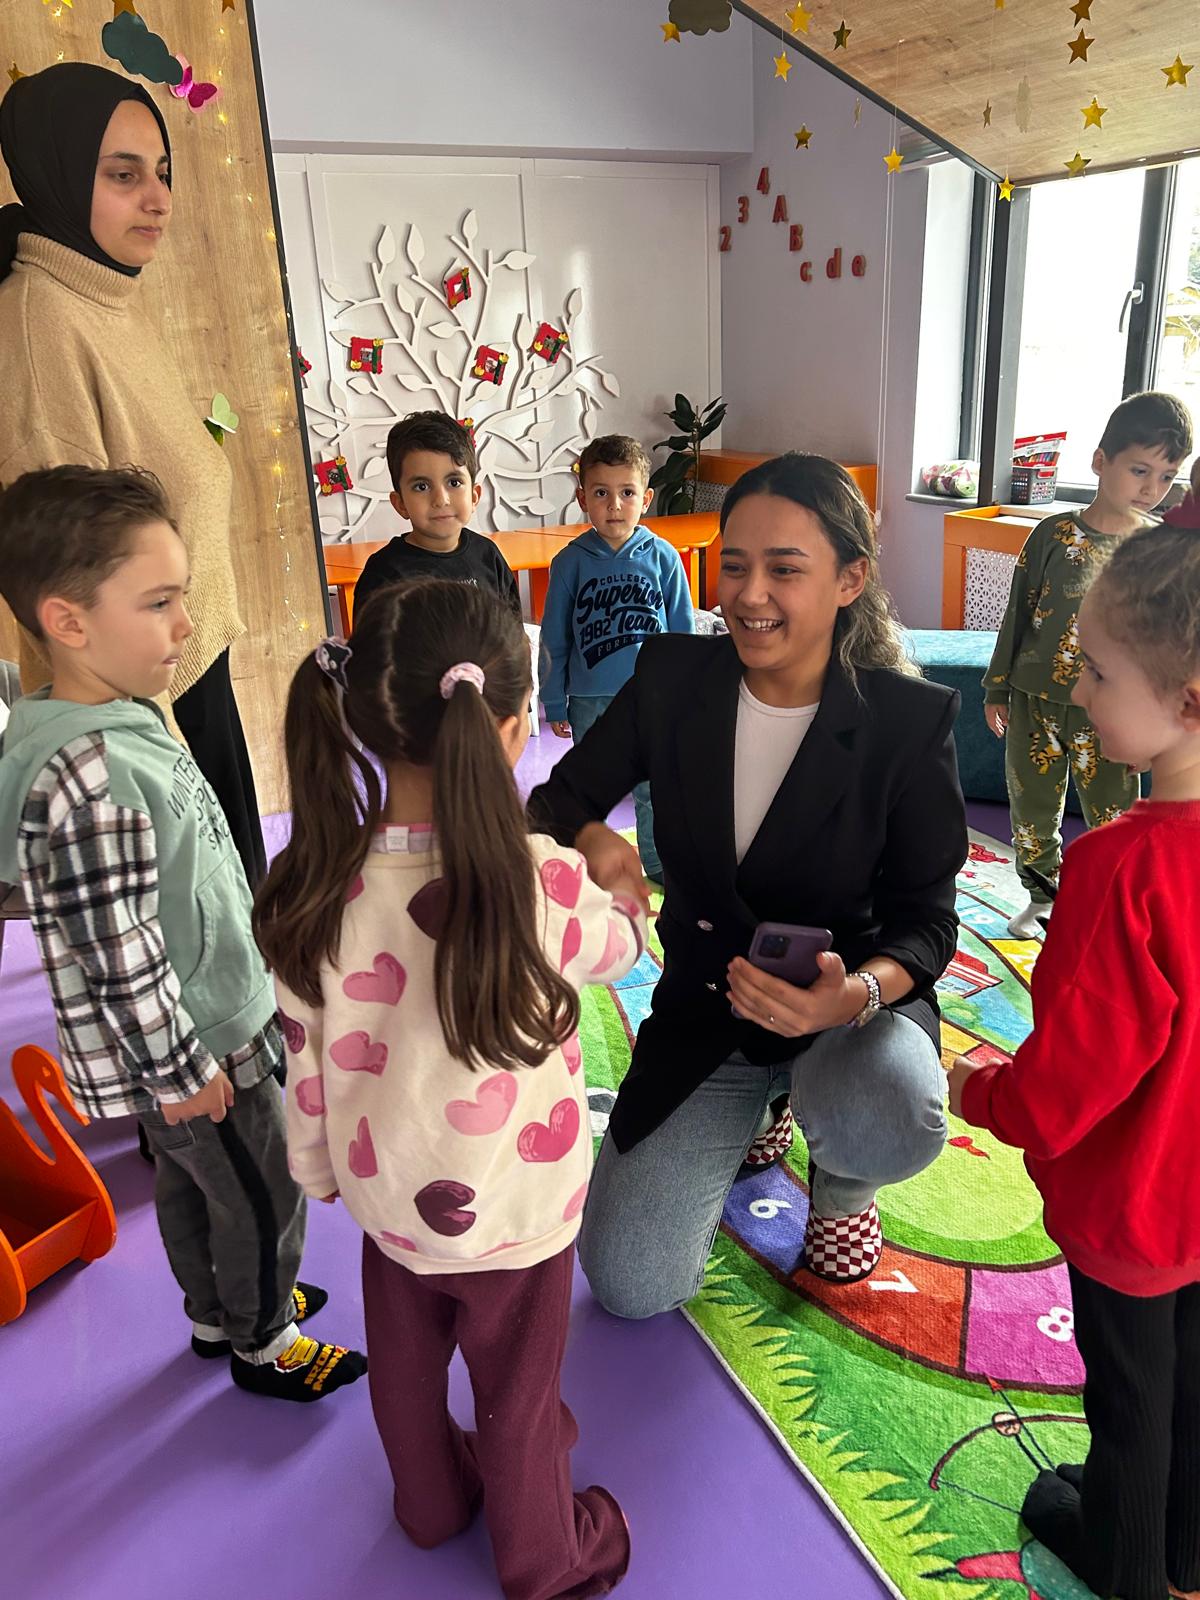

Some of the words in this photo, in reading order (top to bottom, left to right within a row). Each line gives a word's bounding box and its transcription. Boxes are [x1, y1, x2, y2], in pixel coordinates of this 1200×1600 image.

[757, 167, 769, 194] 4
[738, 196, 749, 223] 3
[772, 195, 788, 223] A
[720, 226, 731, 252] 2
[789, 225, 803, 252] B
[826, 247, 841, 278] d
[851, 255, 866, 276] e
[600, 574, 646, 585] COLLEGE
[577, 578, 664, 625] Superior
[580, 618, 611, 649] 1982
[610, 606, 662, 633] Team
[167, 752, 198, 819] WINTER
[1037, 1307, 1074, 1342] 8
